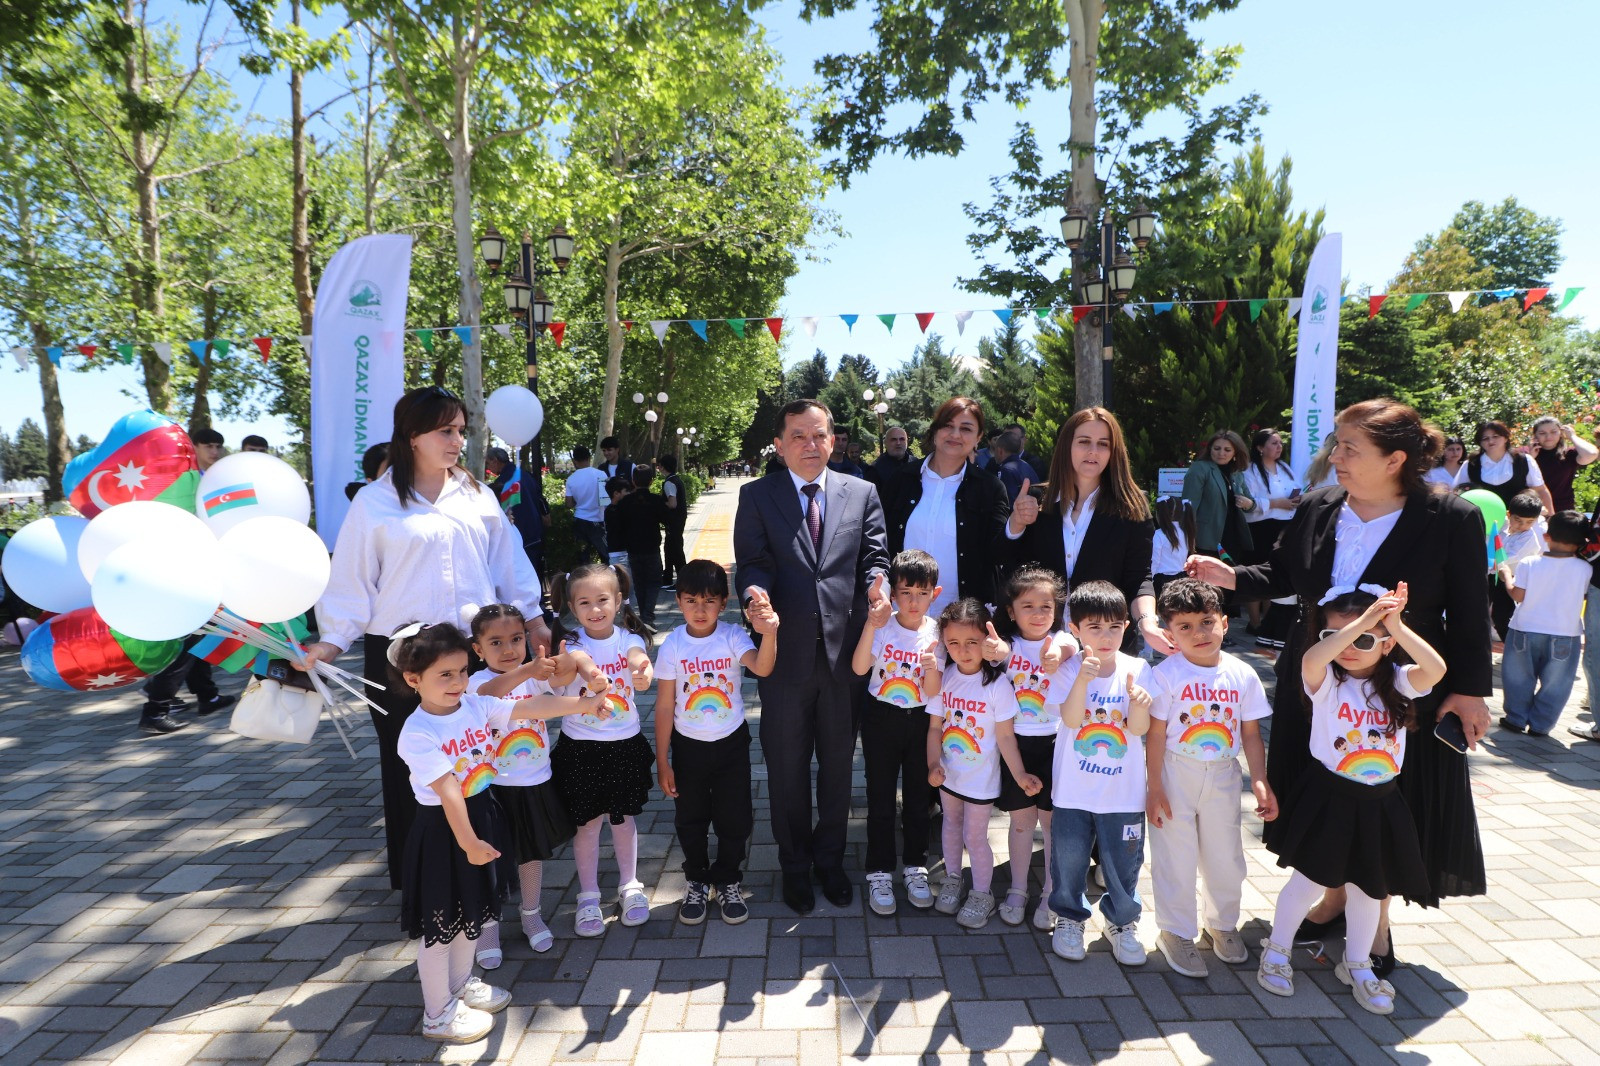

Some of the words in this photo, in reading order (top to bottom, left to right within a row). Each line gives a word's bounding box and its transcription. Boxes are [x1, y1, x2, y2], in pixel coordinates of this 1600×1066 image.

[354, 335, 370, 394] QAZAX
[354, 398, 372, 455] İDMAN
[1306, 409, 1322, 456] İDMA
[354, 459, 366, 482] PA
[883, 643, 926, 663] Şami
[681, 657, 732, 675] Telman
[942, 691, 987, 713] Almaz
[1090, 690, 1125, 706] İyun
[1180, 682, 1239, 704] Alixan
[1337, 702, 1391, 728] Aynu
